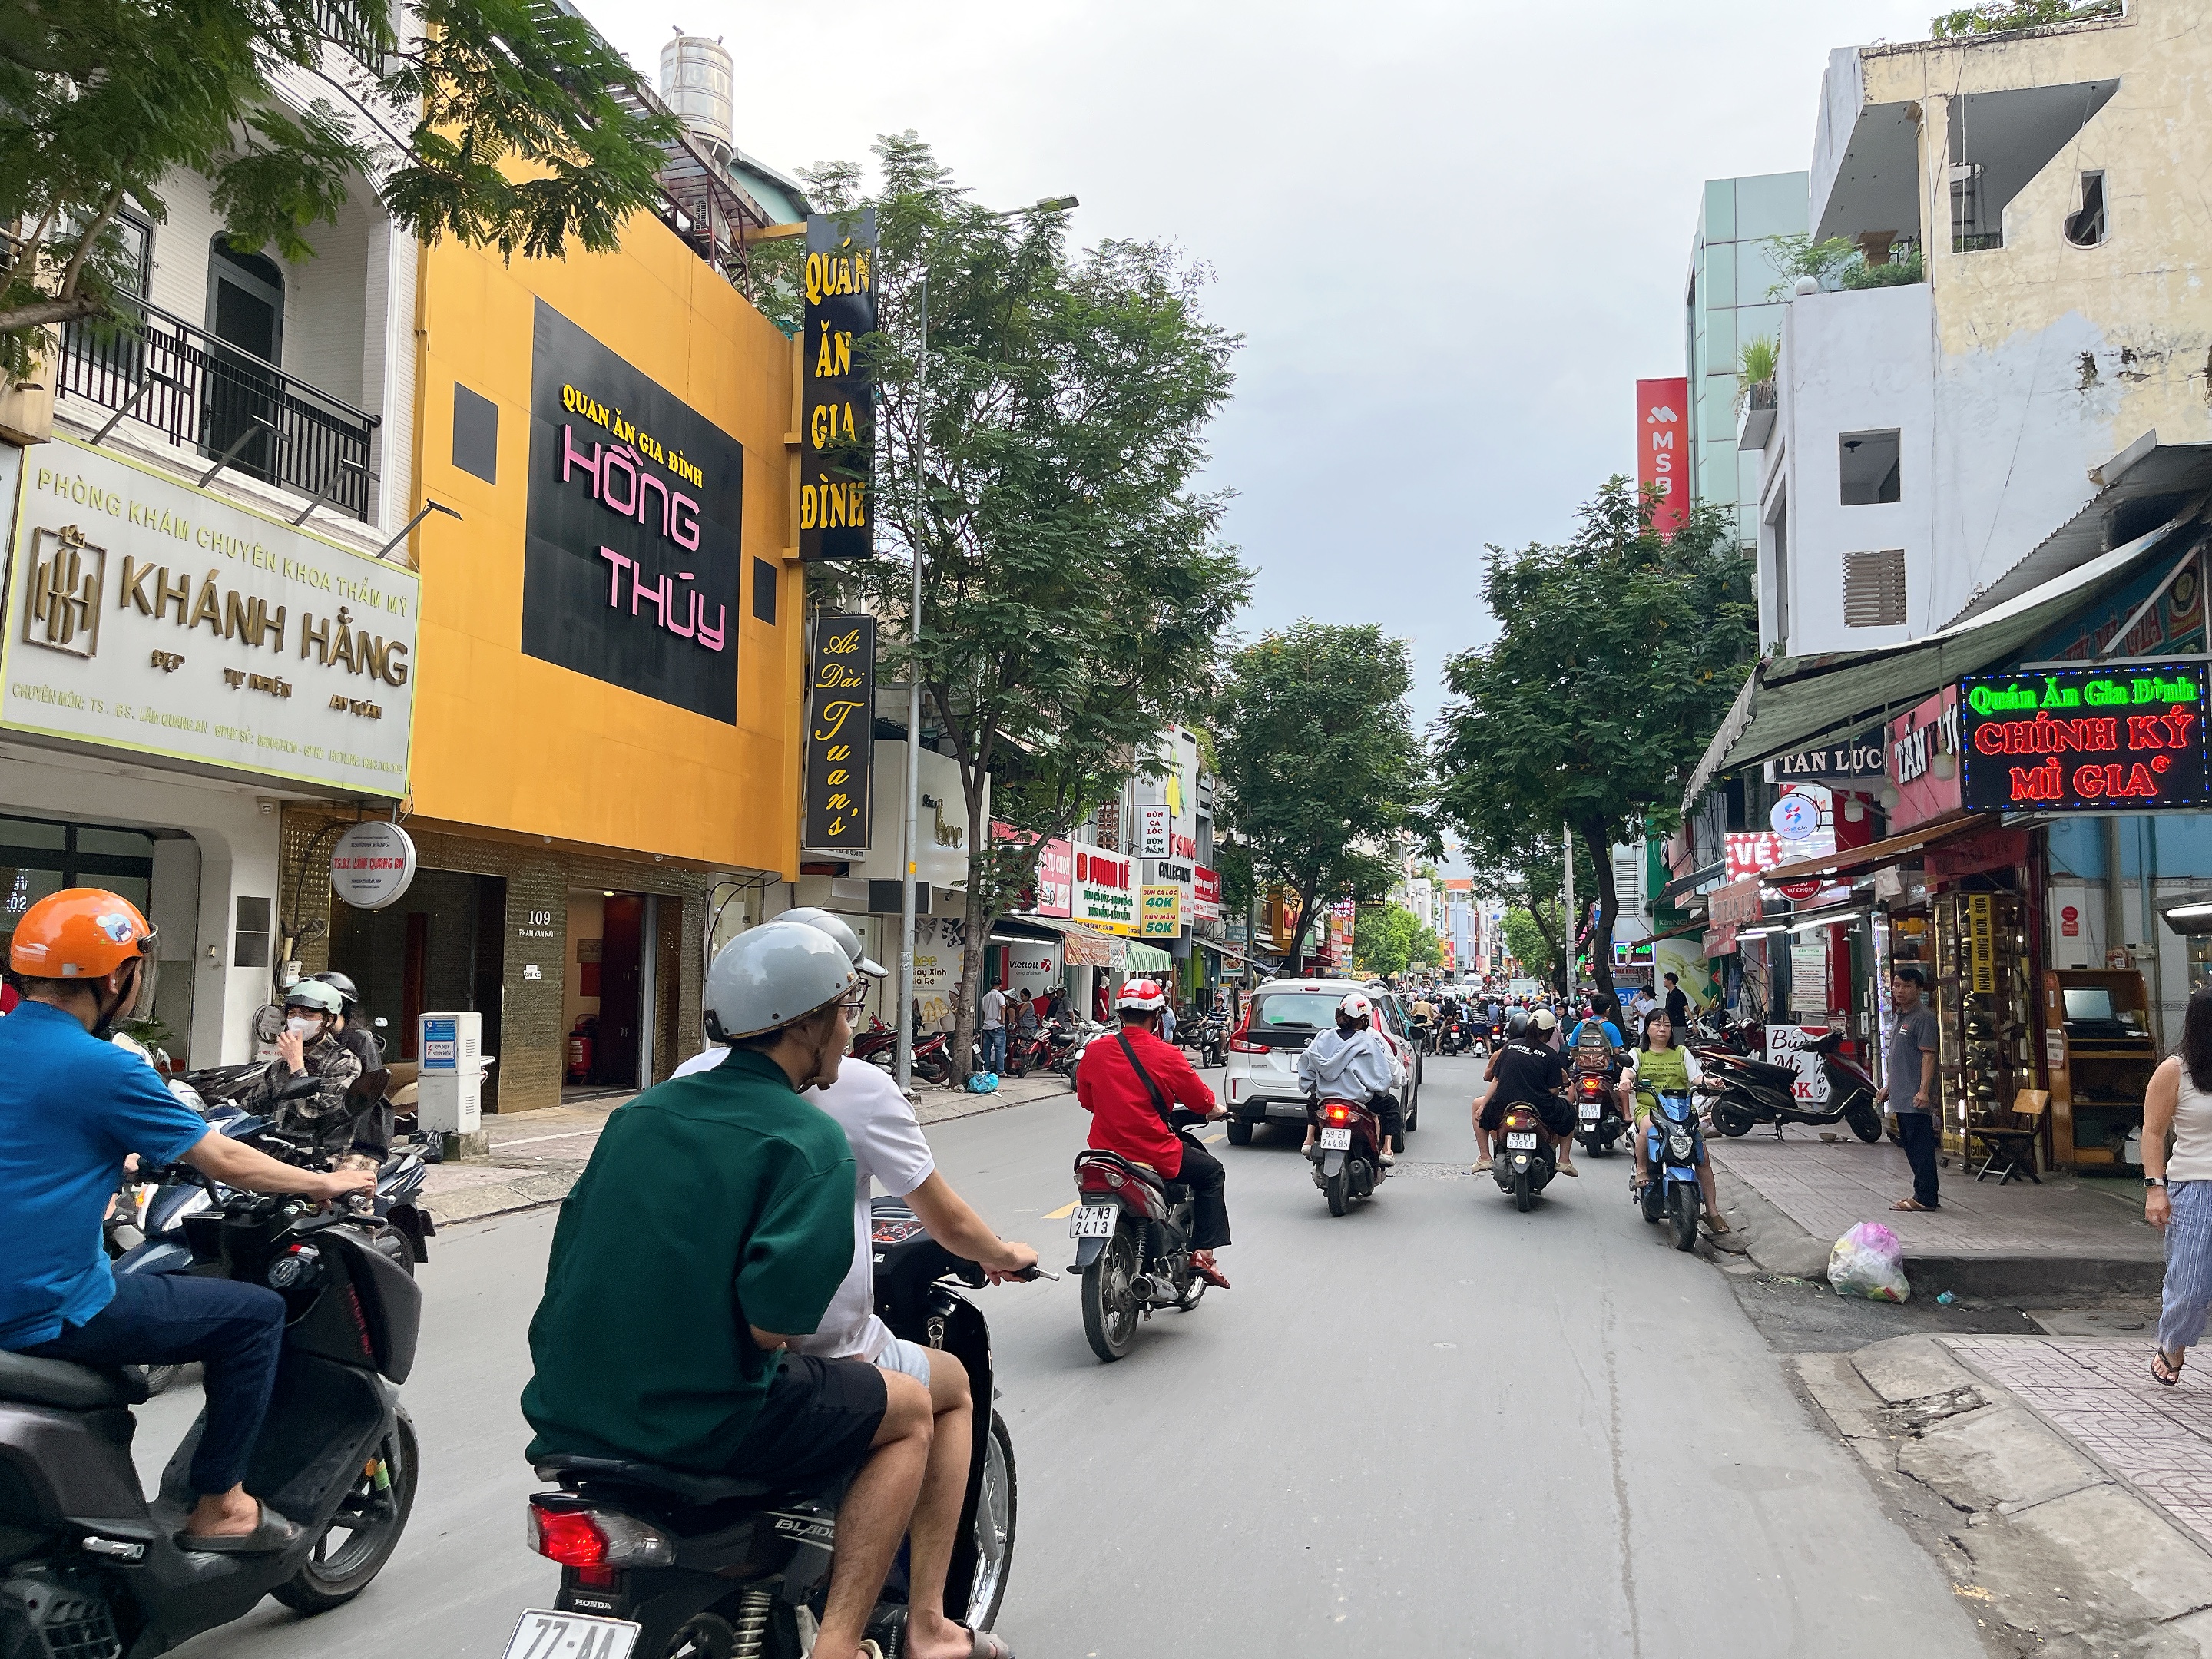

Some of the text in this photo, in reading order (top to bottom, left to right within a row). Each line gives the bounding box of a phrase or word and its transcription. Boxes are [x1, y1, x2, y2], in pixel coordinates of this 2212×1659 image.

[806, 237, 871, 306] QUÁN
[816, 320, 851, 378] ĂN
[612, 407, 636, 445] ĂN
[639, 432, 664, 465] GIA
[668, 449, 704, 489] ĐÌNH
[1652, 431, 1673, 495] MSB
[801, 473, 866, 530] ĐÌNH
[38, 466, 121, 517] PHÒNG
[129, 500, 190, 542] KHÁM
[196, 525, 277, 574] CHUYÊN
[283, 558, 332, 593] KHOA
[336, 575, 382, 610] THẨM
[121, 555, 408, 687] KHÁNH HẰNG
[816, 663, 866, 688] Dài
[1969, 677, 2199, 715] Quán Ăn Gia Đình
[1974, 710, 2118, 756] CHÍNH
[2009, 757, 2065, 800] MÌ
[1147, 836, 1164, 845] BÚN
[528, 910, 551, 926] 109
[1146, 897, 1174, 908] 40K
[1146, 922, 1174, 932] 50K
[1009, 960, 1039, 969] Vietlott
[1075, 1221, 1108, 1236] 2413
[1078, 1207, 1111, 1220] 47-N3
[575, 1598, 612, 1610] HONDA
